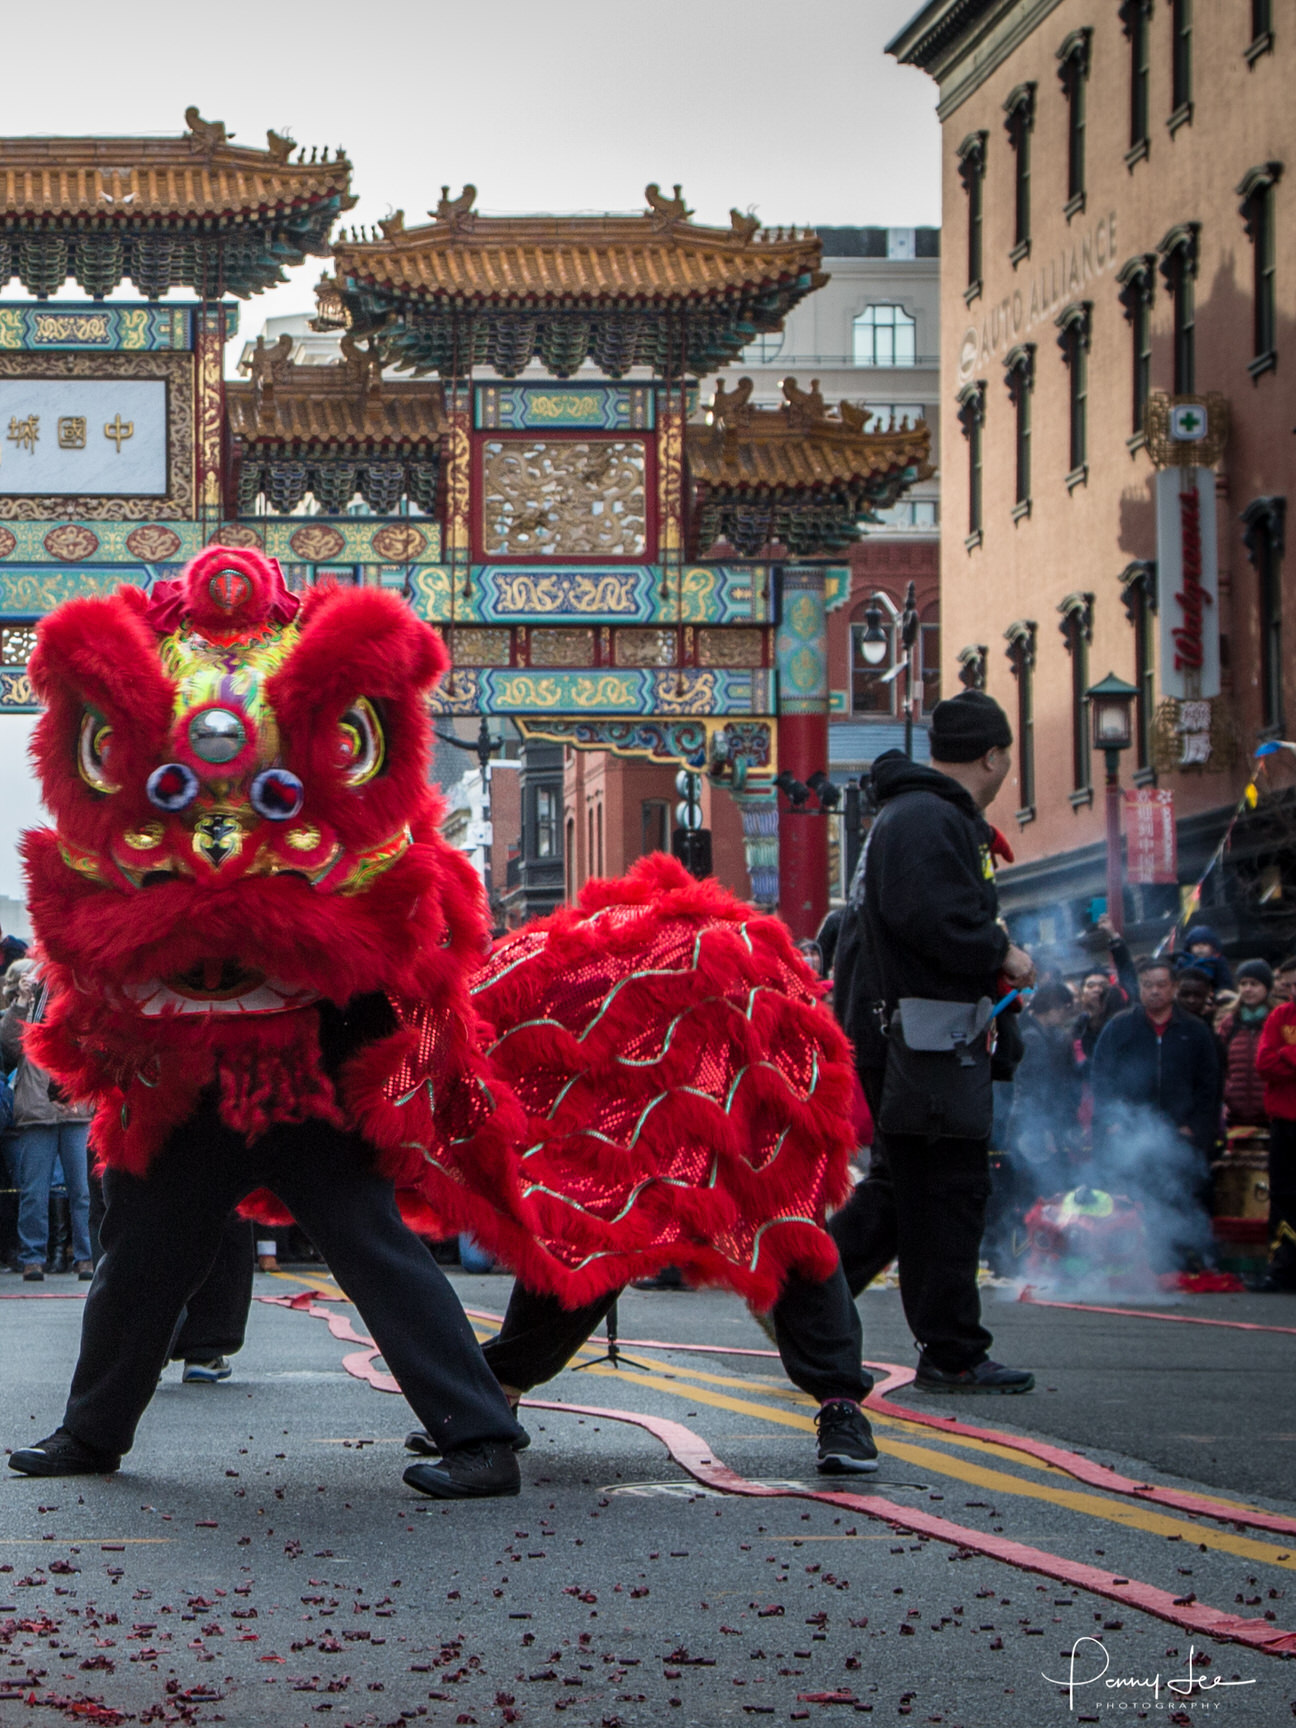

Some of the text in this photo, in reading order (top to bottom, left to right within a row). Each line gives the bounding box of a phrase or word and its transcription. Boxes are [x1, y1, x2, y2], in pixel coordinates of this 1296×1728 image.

[981, 210, 1117, 358] AUTO ALLIANCE
[6, 412, 134, 455] 中國城
[1171, 485, 1214, 672] Walgreens
